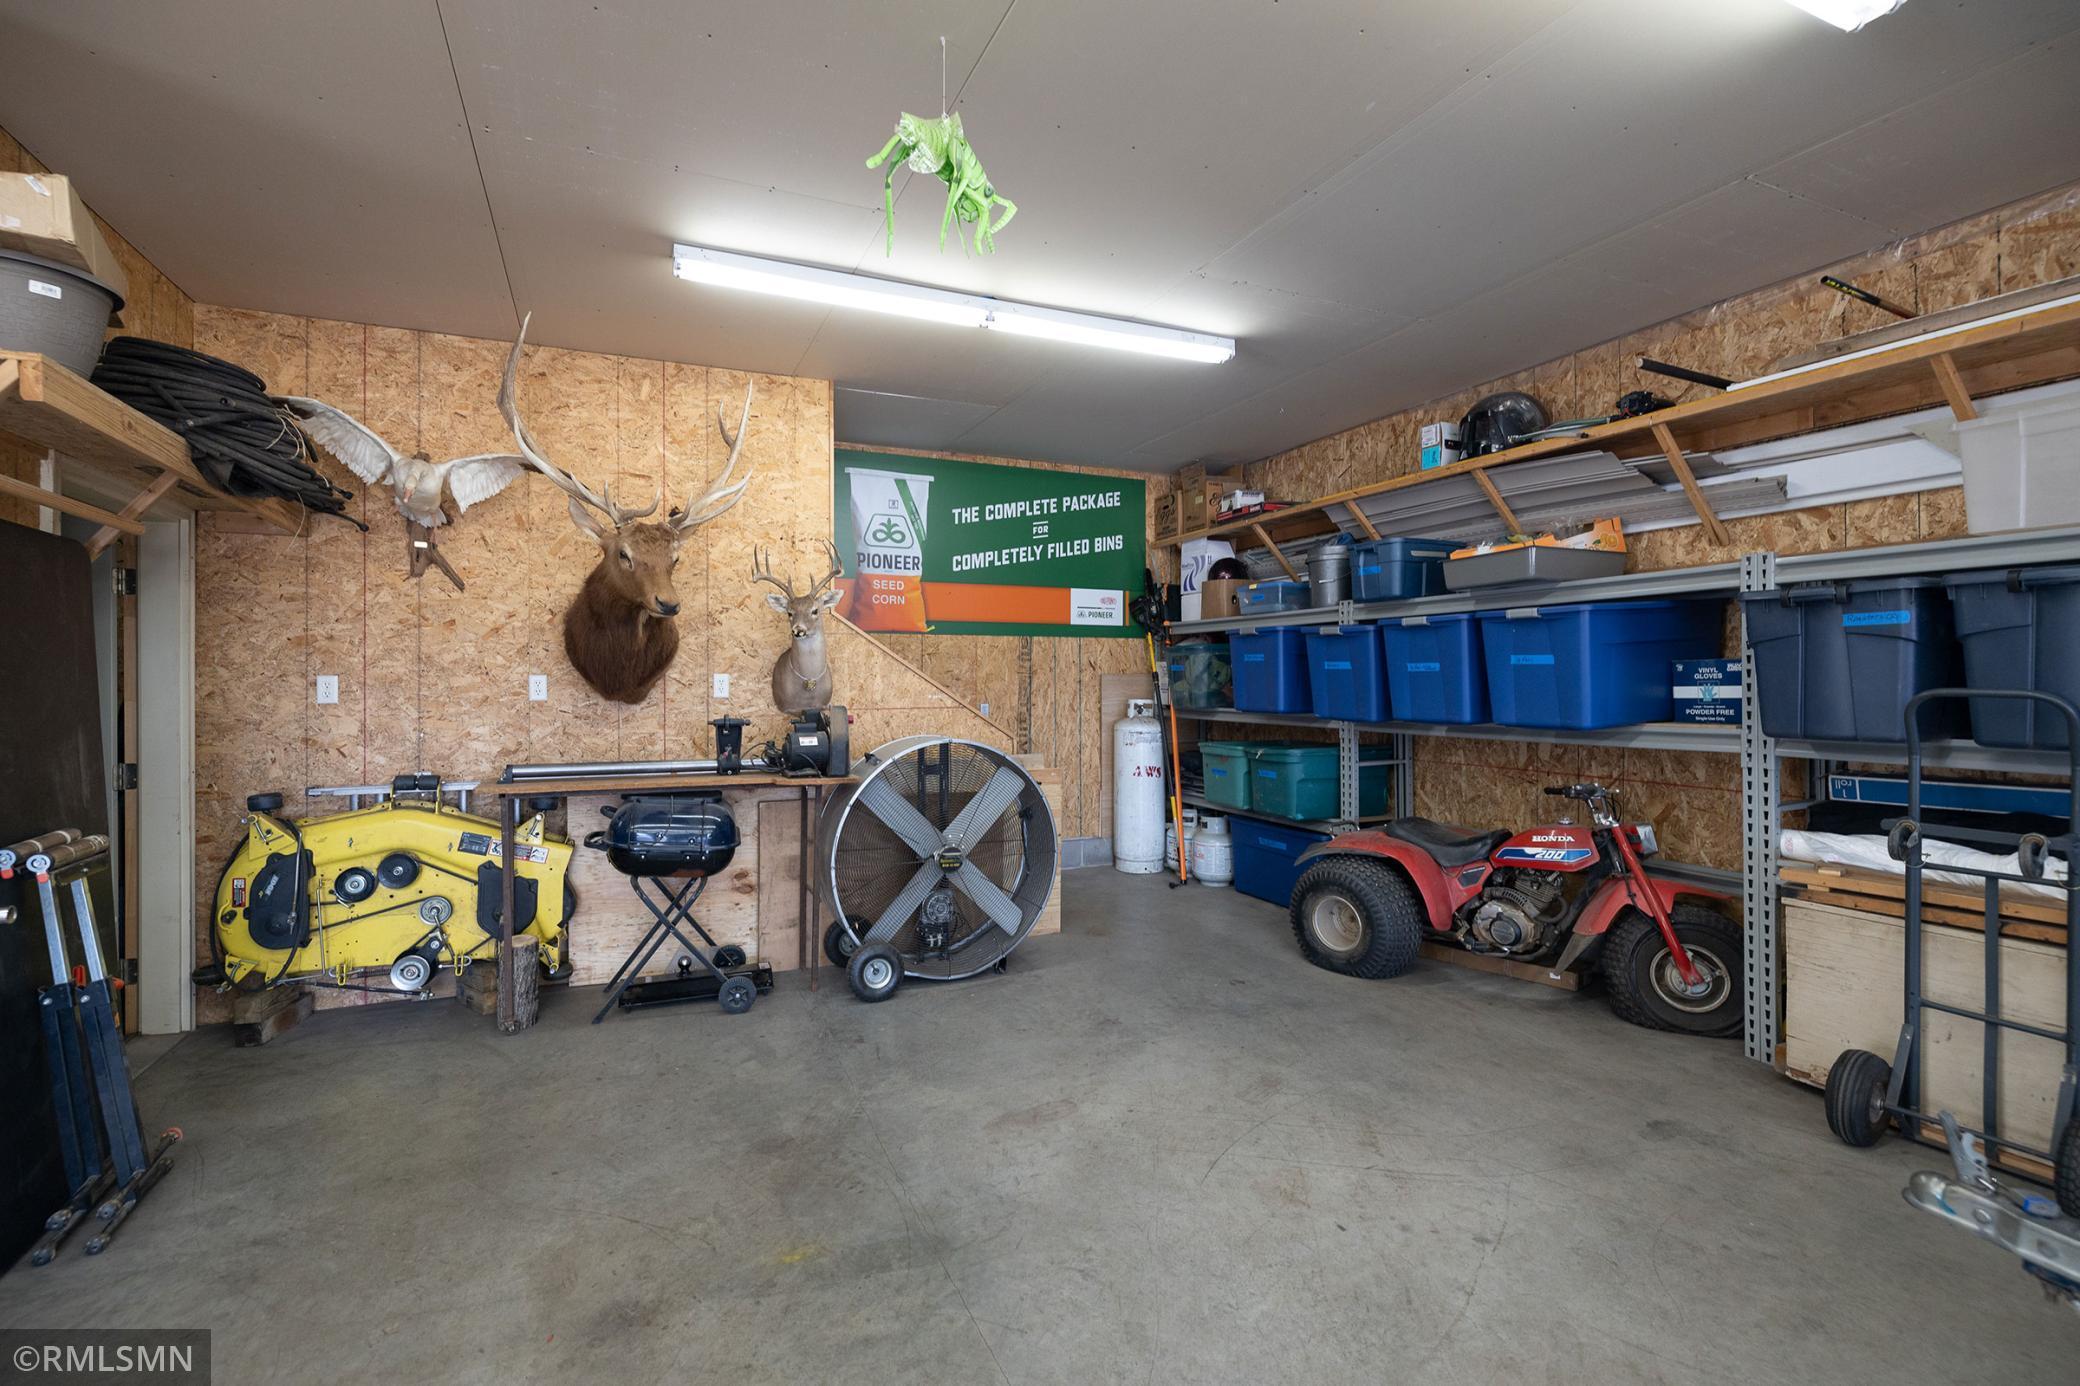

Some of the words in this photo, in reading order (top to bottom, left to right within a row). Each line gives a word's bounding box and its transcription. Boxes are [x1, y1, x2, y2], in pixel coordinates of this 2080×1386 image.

[952, 506, 980, 525] THE
[985, 498, 1058, 521] COMPLETE
[1062, 491, 1121, 512] PACKAGE
[1032, 525, 1049, 535] FOR
[952, 544, 1043, 572] COMPLETELY
[1047, 539, 1090, 559] FILLED
[1094, 534, 1123, 553] BINS
[857, 552, 921, 571] PIONEER
[872, 579, 905, 590] SEED
[872, 594, 905, 605] CORN
[1087, 611, 1113, 619] PIONEER
[1835, 779, 1852, 789] roll
[1842, 789, 1847, 798] 1
[1535, 850, 1566, 859] 200
